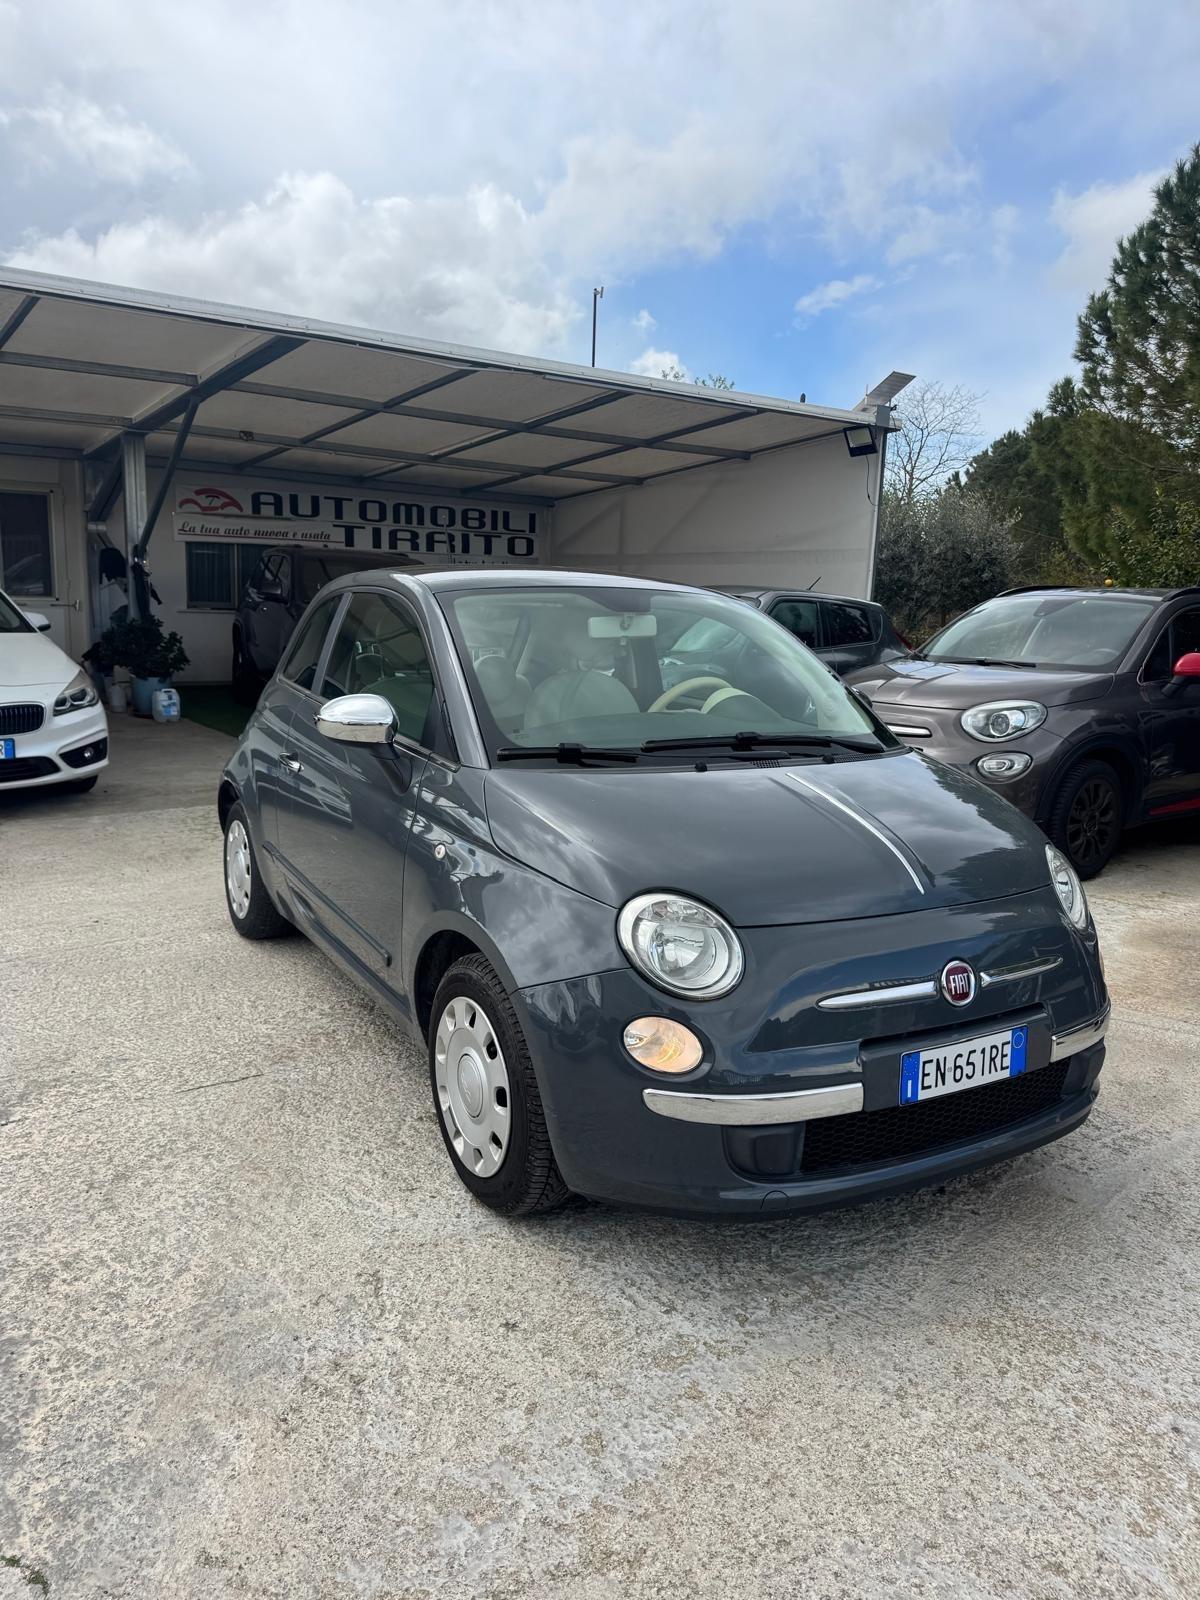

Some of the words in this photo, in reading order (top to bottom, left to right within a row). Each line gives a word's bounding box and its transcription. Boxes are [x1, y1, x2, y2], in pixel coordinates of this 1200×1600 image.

[251, 491, 537, 534] AUTOMOBILI
[178, 521, 196, 533] La
[200, 523, 220, 535] tua
[223, 526, 250, 536] auto
[254, 530, 289, 539] nuova
[300, 531, 331, 541] usata
[332, 524, 535, 557] TIRRITO
[950, 973, 969, 995] FIAT
